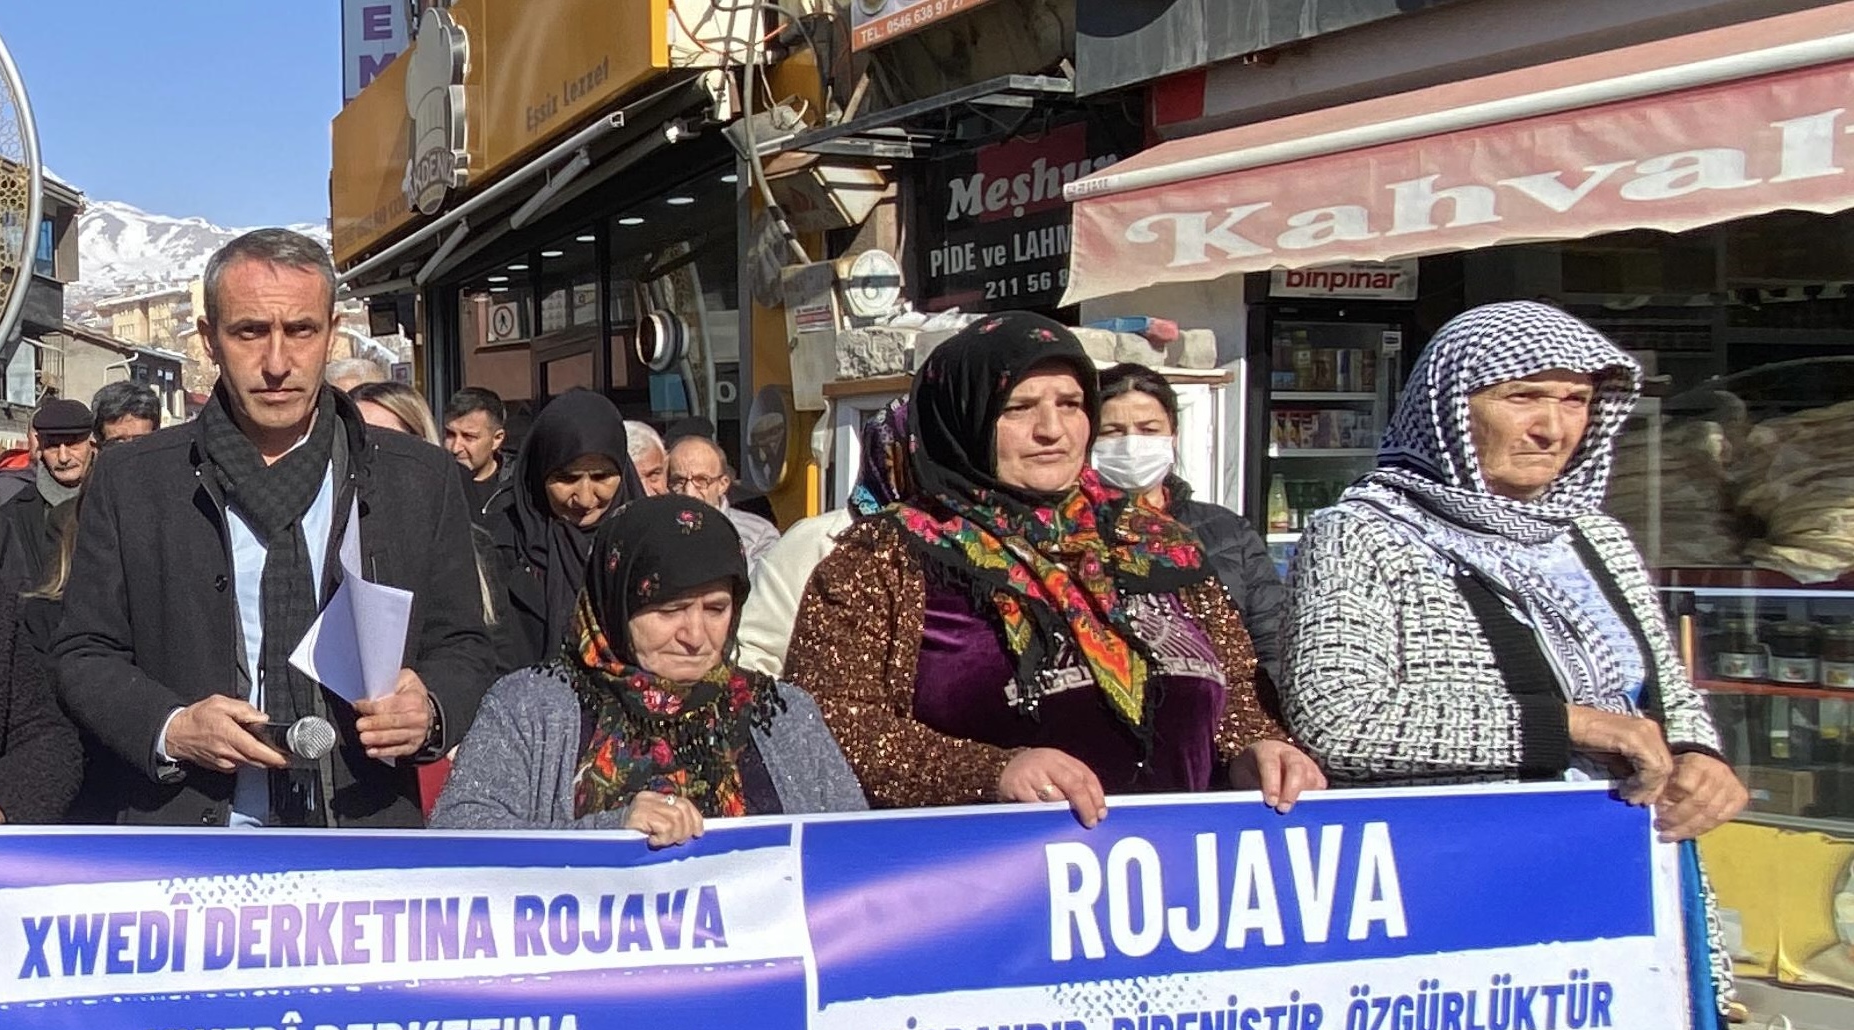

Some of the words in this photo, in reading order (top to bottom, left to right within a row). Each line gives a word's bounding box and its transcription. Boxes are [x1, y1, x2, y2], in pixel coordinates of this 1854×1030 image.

[1125, 107, 1854, 268] Kahval
[930, 239, 977, 278] PİDE
[982, 244, 1007, 269] ve
[985, 277, 1019, 300] 211
[1027, 272, 1052, 293] 56
[18, 893, 191, 980] XWEDÎ
[200, 895, 498, 972] DERKETINA
[513, 885, 729, 956] ROJAVA
[1044, 820, 1408, 962] ROJAVA
